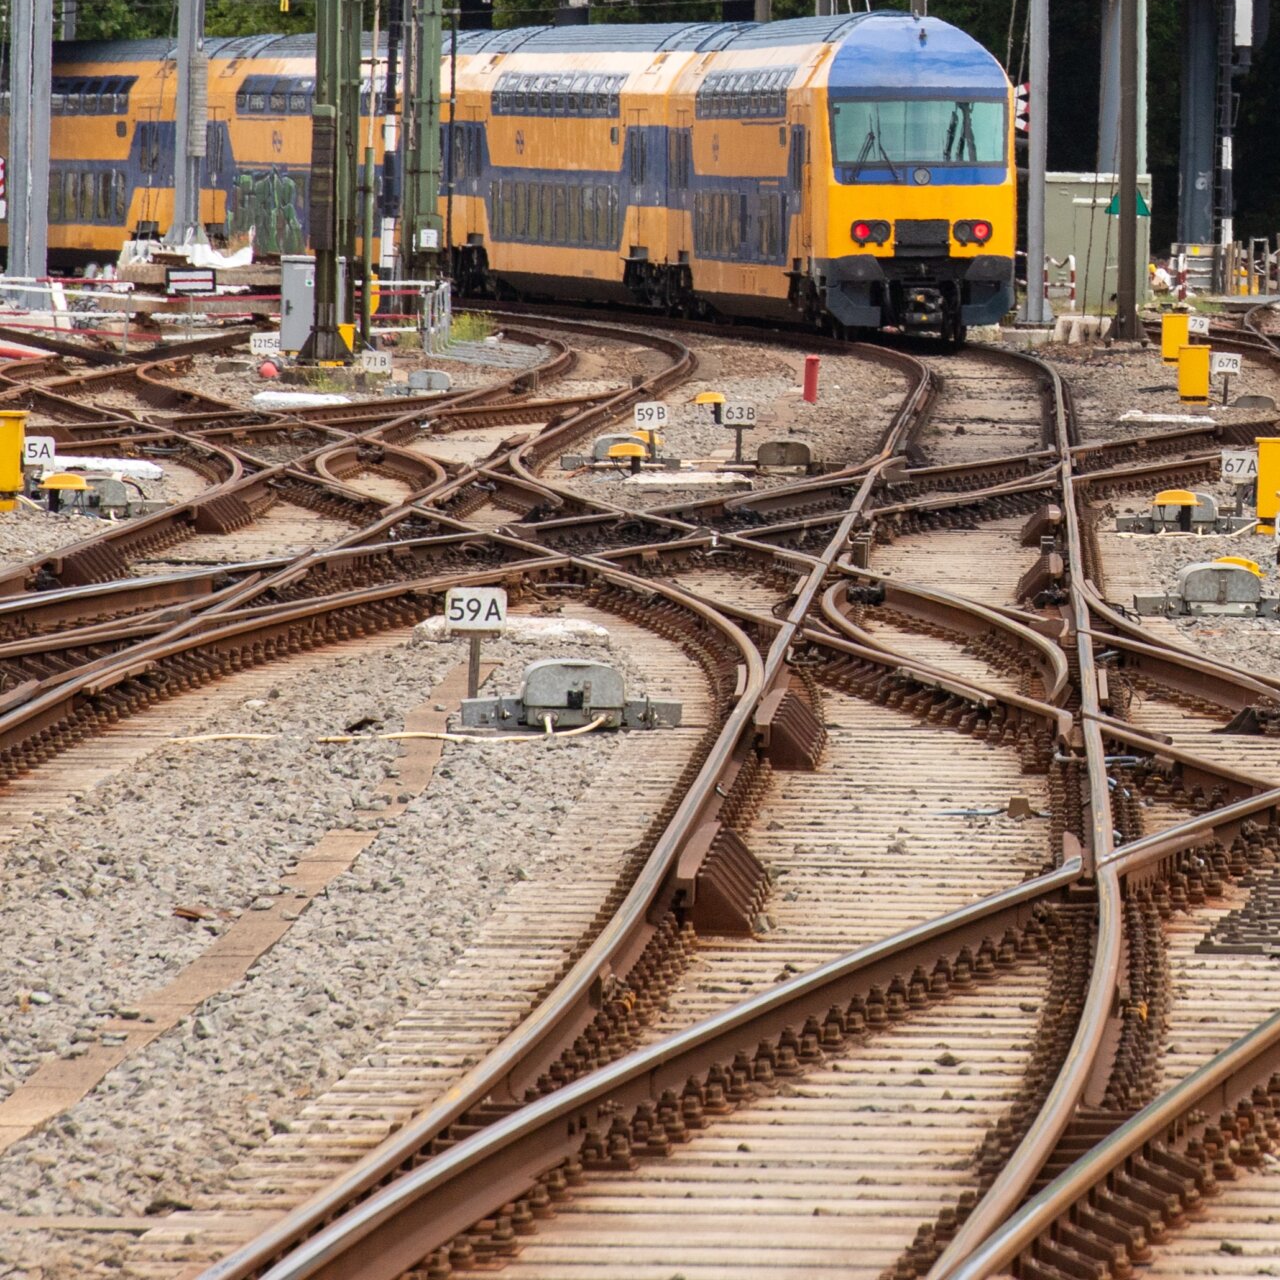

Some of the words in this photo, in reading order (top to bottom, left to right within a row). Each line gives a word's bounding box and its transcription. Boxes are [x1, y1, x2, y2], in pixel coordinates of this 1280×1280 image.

[1191, 319, 1205, 329] 79
[366, 356, 387, 367] 71B
[1218, 358, 1238, 369] 67B
[637, 406, 666, 421] 59B
[725, 406, 756, 420] 63B
[23, 442, 51, 458] 5A
[1224, 457, 1258, 474] 67A
[449, 596, 503, 622] 59A
